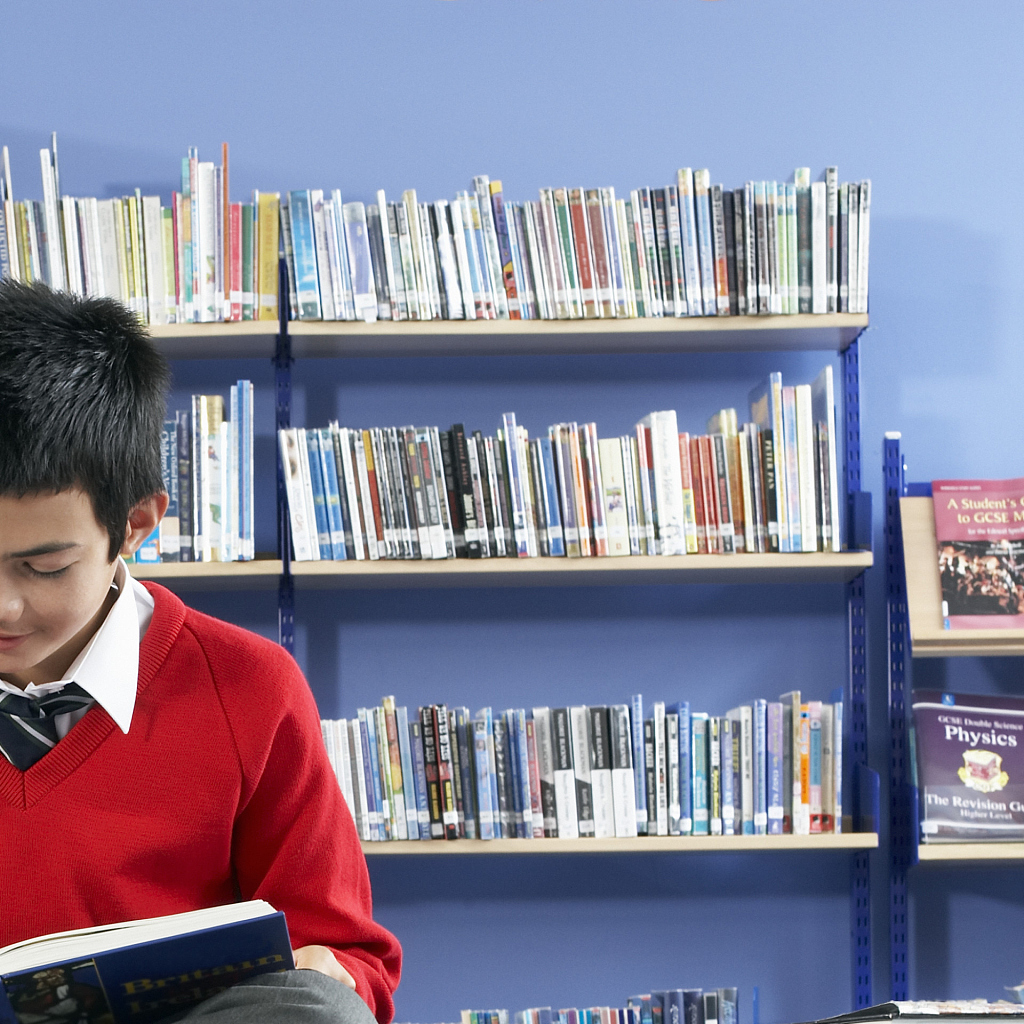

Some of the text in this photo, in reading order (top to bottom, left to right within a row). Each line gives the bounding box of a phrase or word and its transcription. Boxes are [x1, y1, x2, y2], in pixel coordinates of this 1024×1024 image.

[457, 432, 469, 485] Bernard Ashley
[765, 440, 775, 488] PETER PAN
[947, 498, 959, 510] A
[961, 497, 1017, 510] Student's
[957, 513, 971, 524] to
[973, 511, 1010, 524] GCSE
[937, 715, 1024, 731] GCSE Double Science
[944, 724, 1018, 747] Physics
[559, 738, 567, 768] BLACKMAN
[596, 737, 604, 768] BLACKMAN
[927, 793, 950, 806] The
[952, 795, 1007, 812] Revision
[960, 808, 1013, 820] Higher Level
[120, 953, 287, 995] Britain
